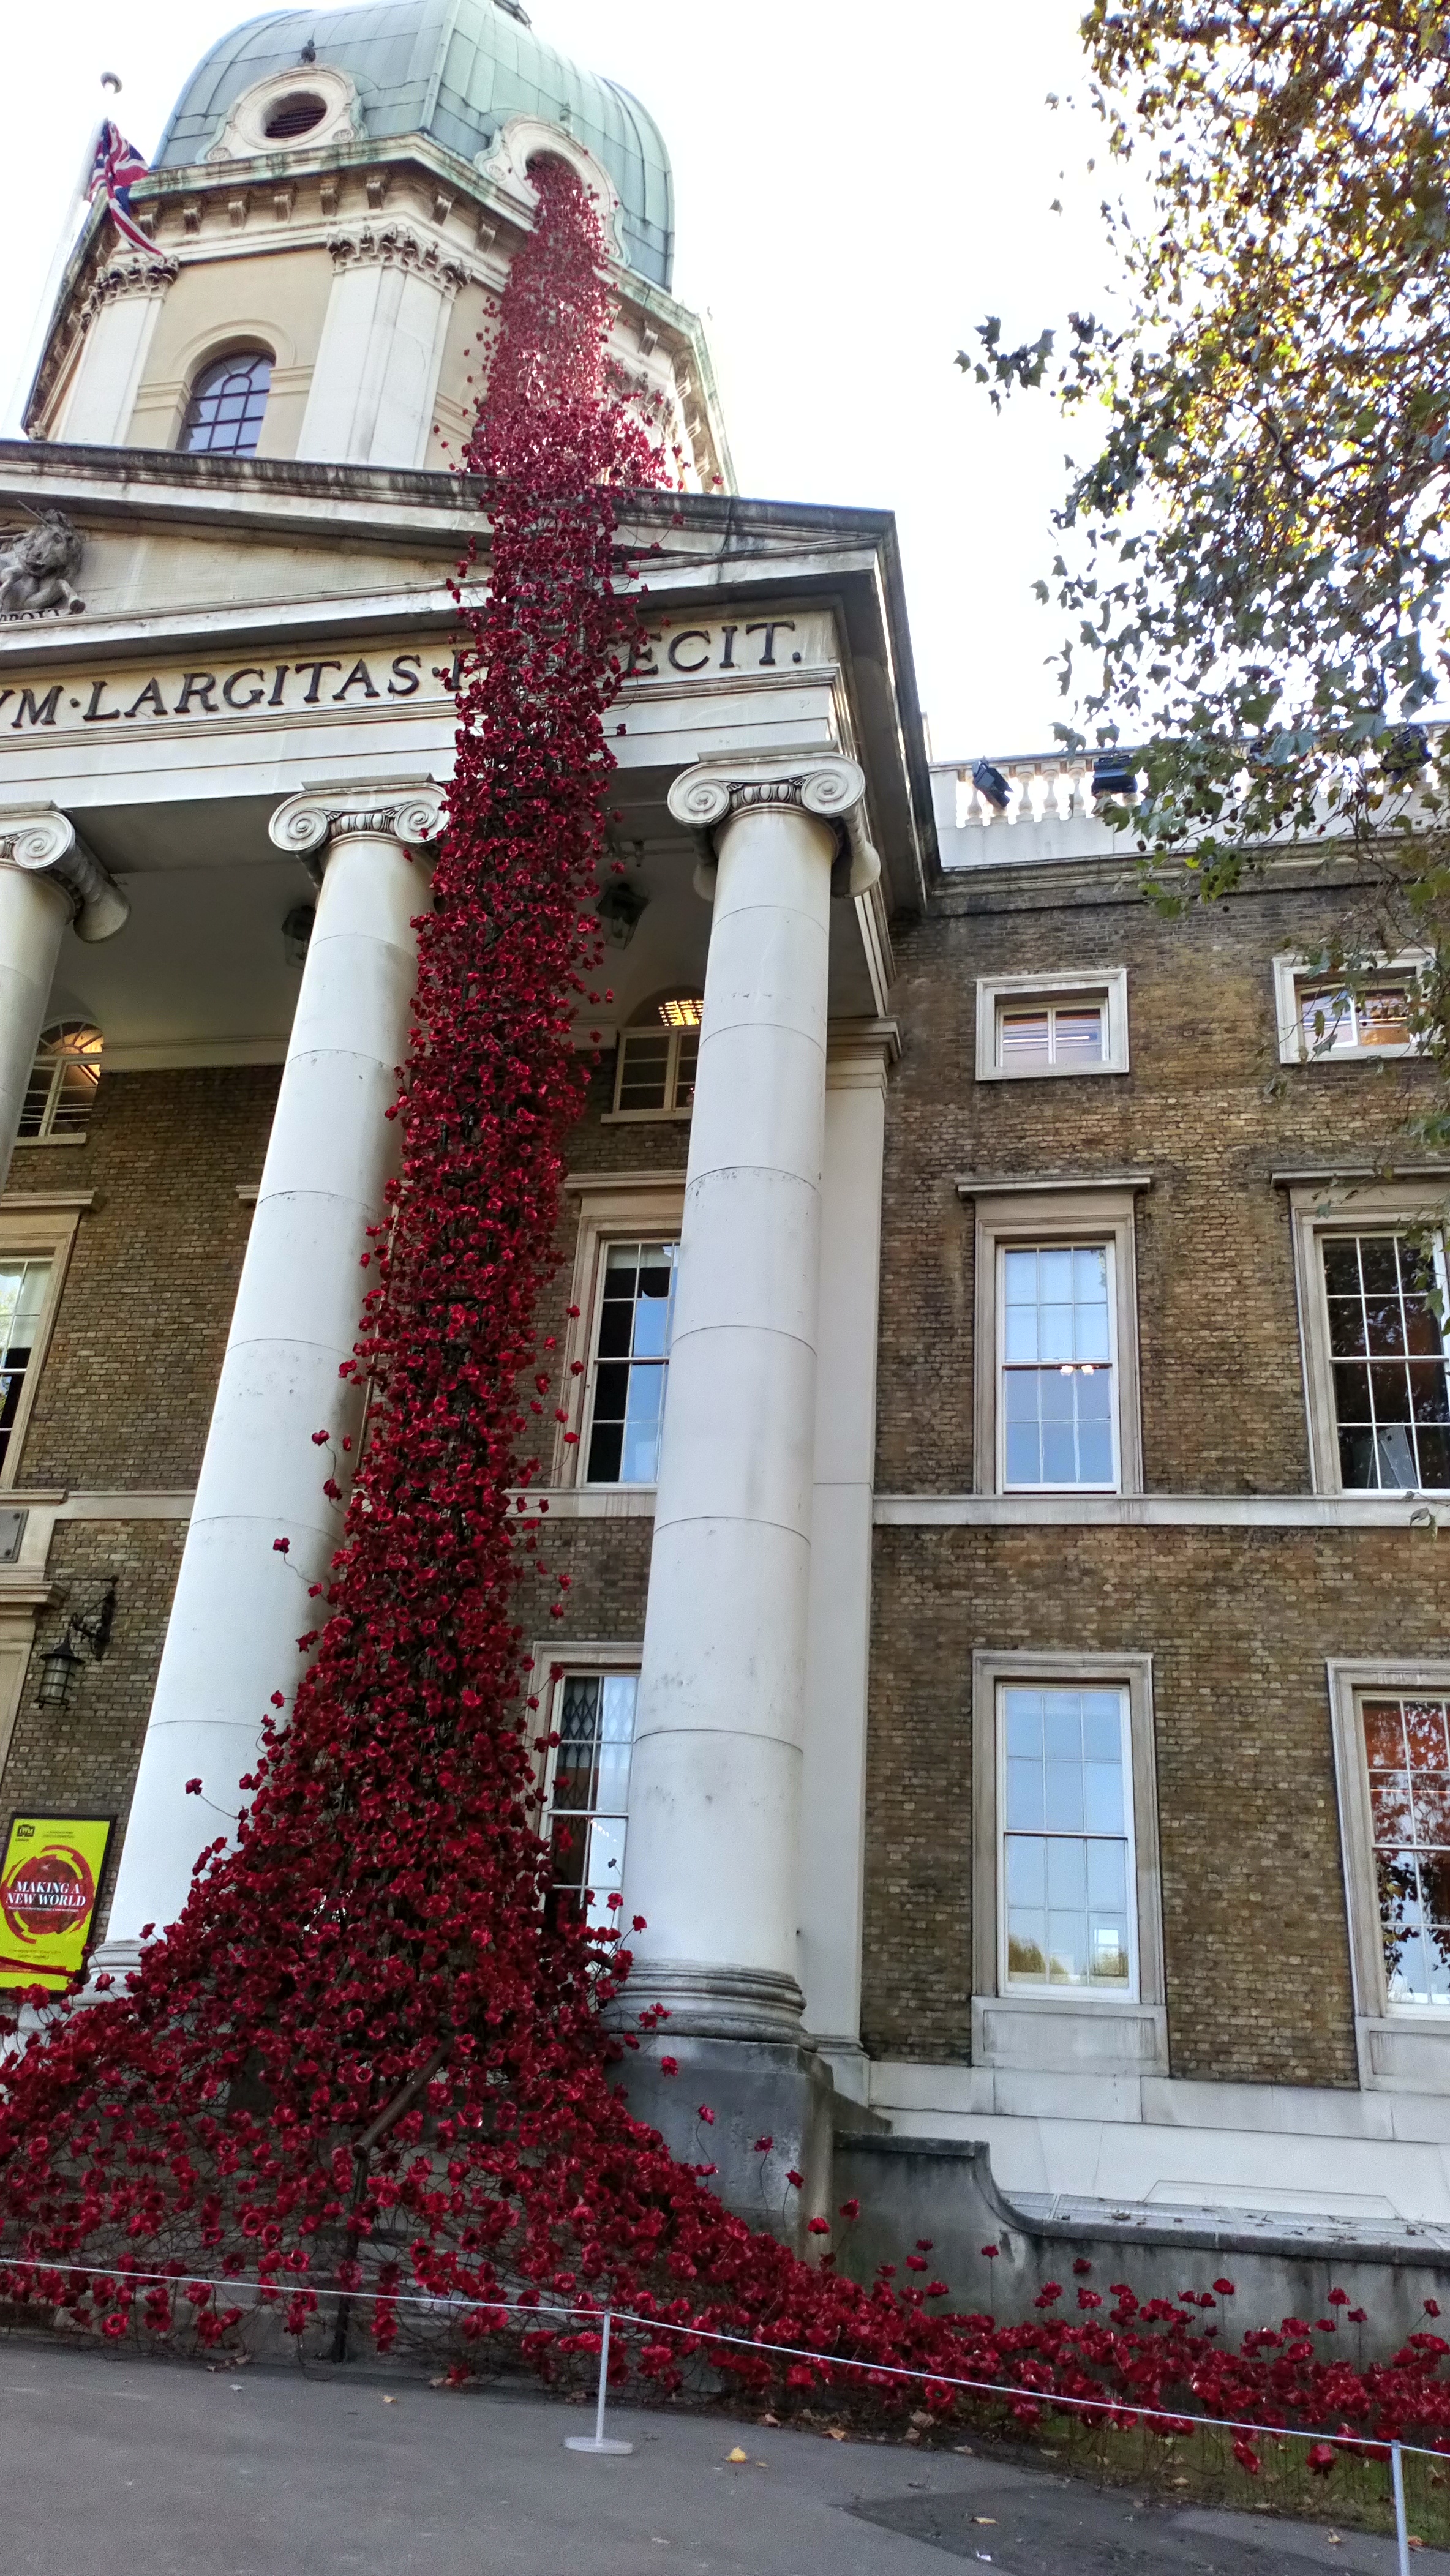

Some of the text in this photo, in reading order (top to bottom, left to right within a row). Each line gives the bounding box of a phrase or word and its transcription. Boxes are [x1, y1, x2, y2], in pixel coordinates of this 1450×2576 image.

[81, 654, 423, 722] LARGITAS
[15, 1881, 80, 1895] MAKING A
[6, 1892, 86, 1907] NEW WORLD
